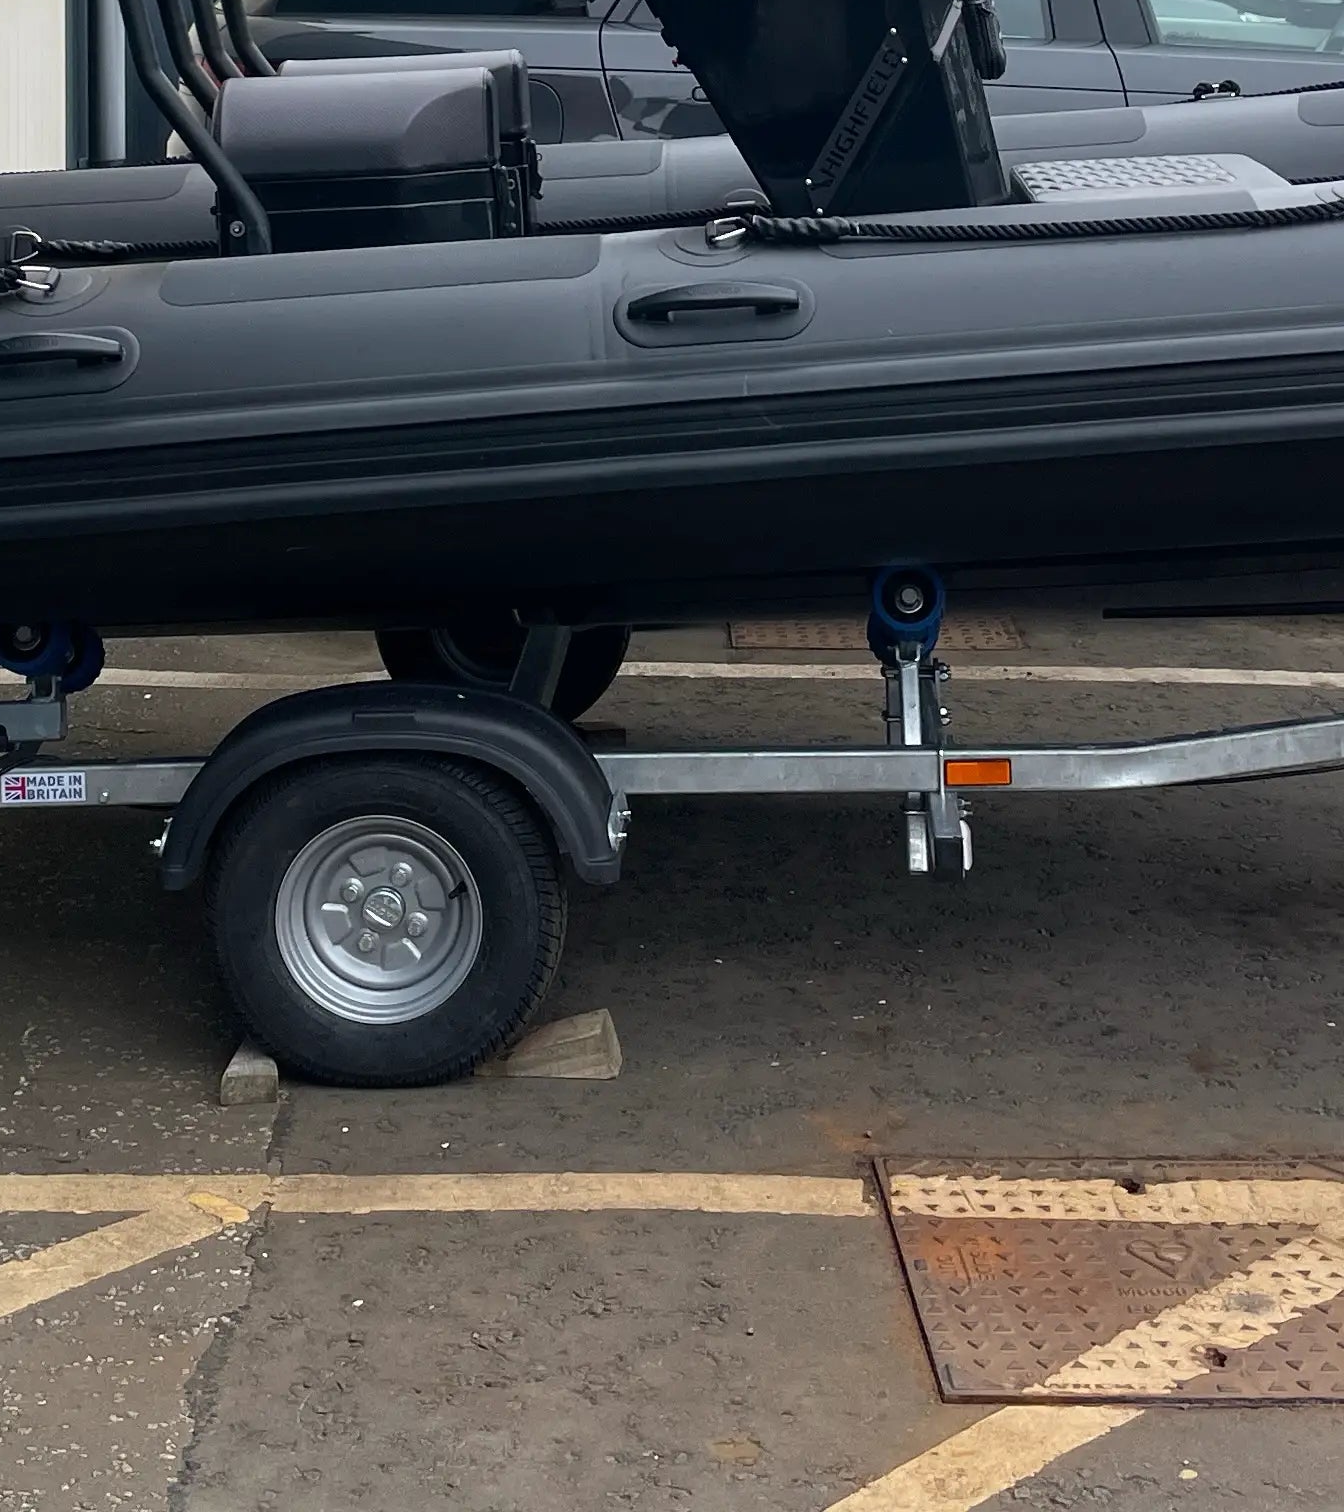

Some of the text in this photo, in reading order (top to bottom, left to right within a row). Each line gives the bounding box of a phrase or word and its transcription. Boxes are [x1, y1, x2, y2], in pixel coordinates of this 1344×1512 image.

[820, 48, 902, 186] HIGHFIELD
[27, 774, 82, 787] MADE IN
[27, 788, 83, 800] BRITAIN
